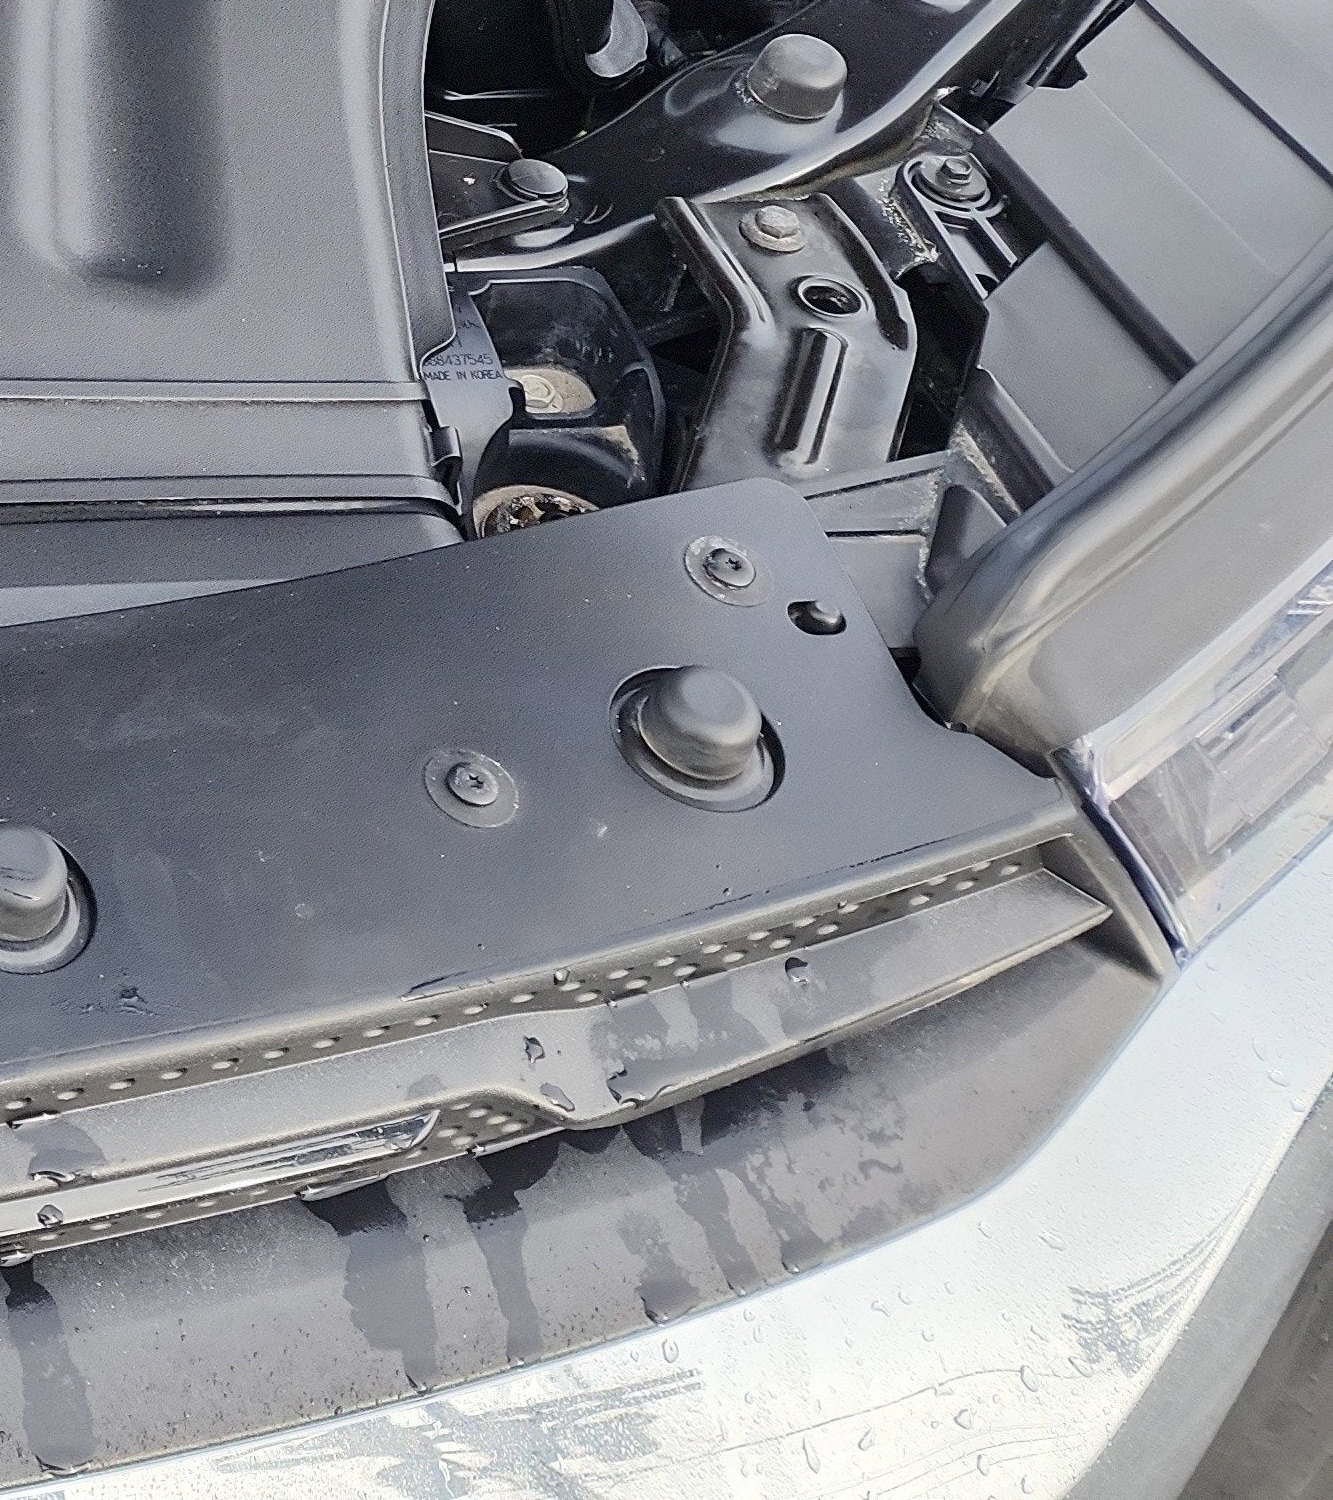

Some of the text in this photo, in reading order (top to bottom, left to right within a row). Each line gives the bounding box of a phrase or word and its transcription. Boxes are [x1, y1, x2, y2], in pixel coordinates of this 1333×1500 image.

[424, 369, 504, 381] MADE IN KOREA
